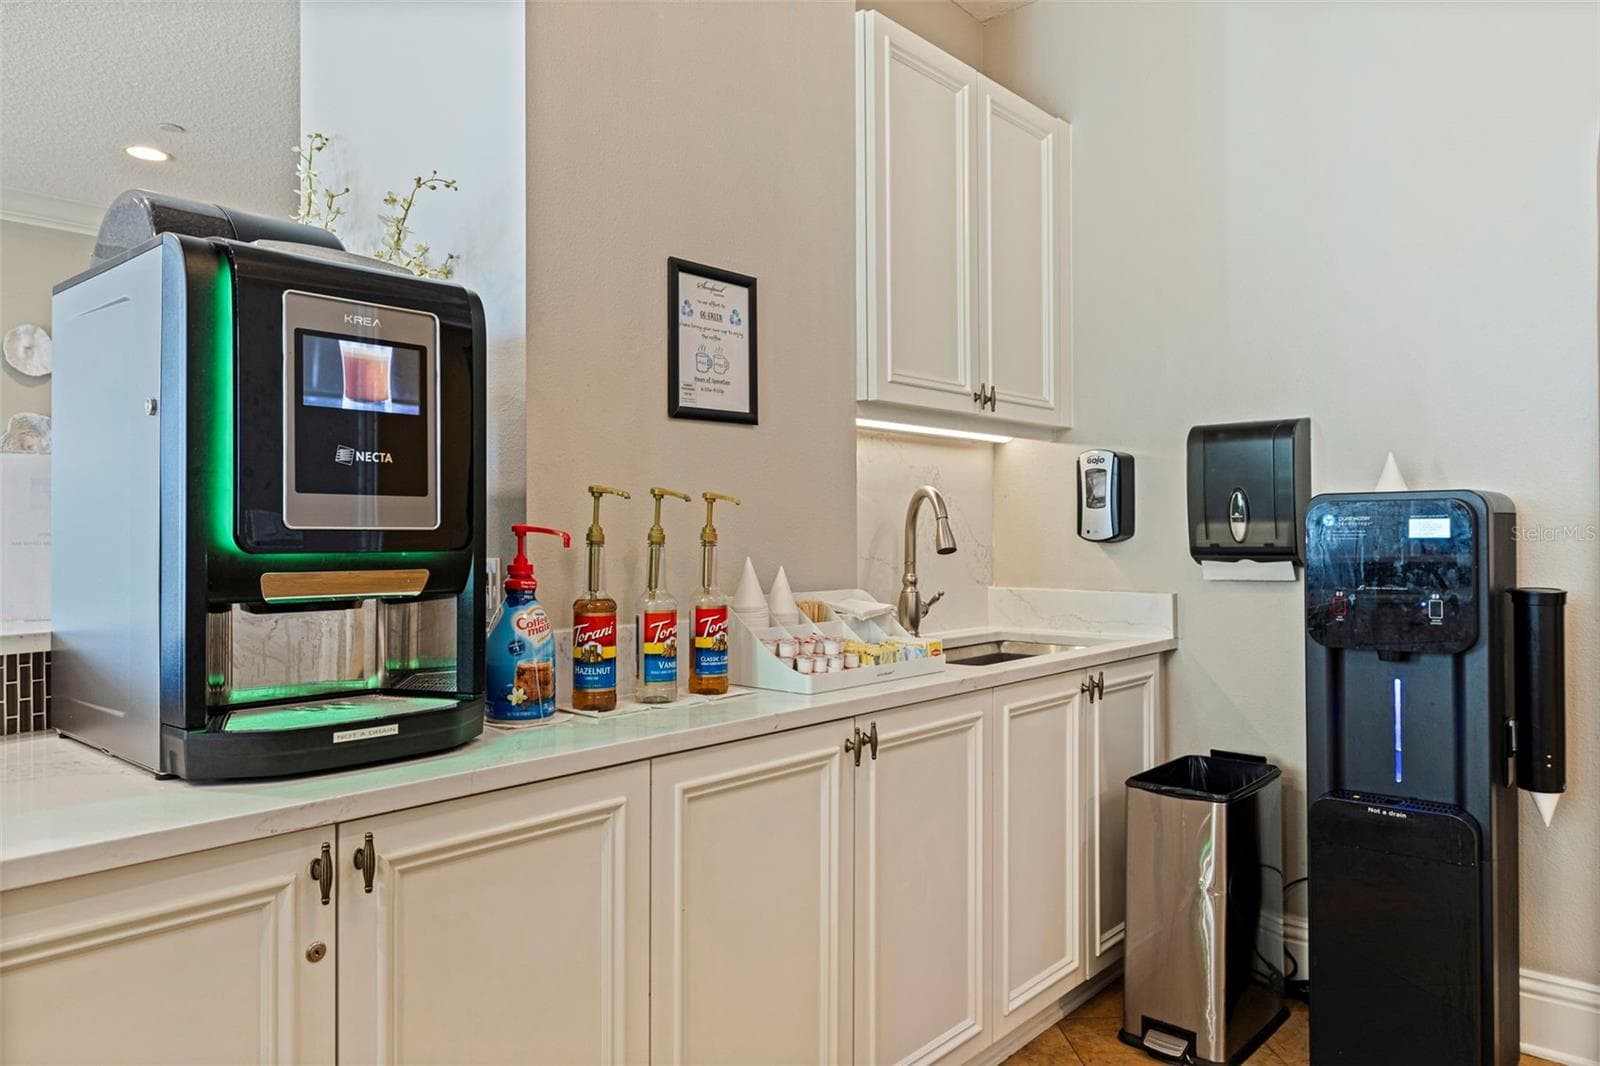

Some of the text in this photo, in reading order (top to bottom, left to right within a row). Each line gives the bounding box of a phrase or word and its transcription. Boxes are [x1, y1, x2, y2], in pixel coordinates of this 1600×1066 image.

[344, 313, 382, 328] KREA
[355, 451, 393, 463] NECTA
[574, 621, 614, 647] Torani
[576, 666, 611, 675] HAZELNUT
